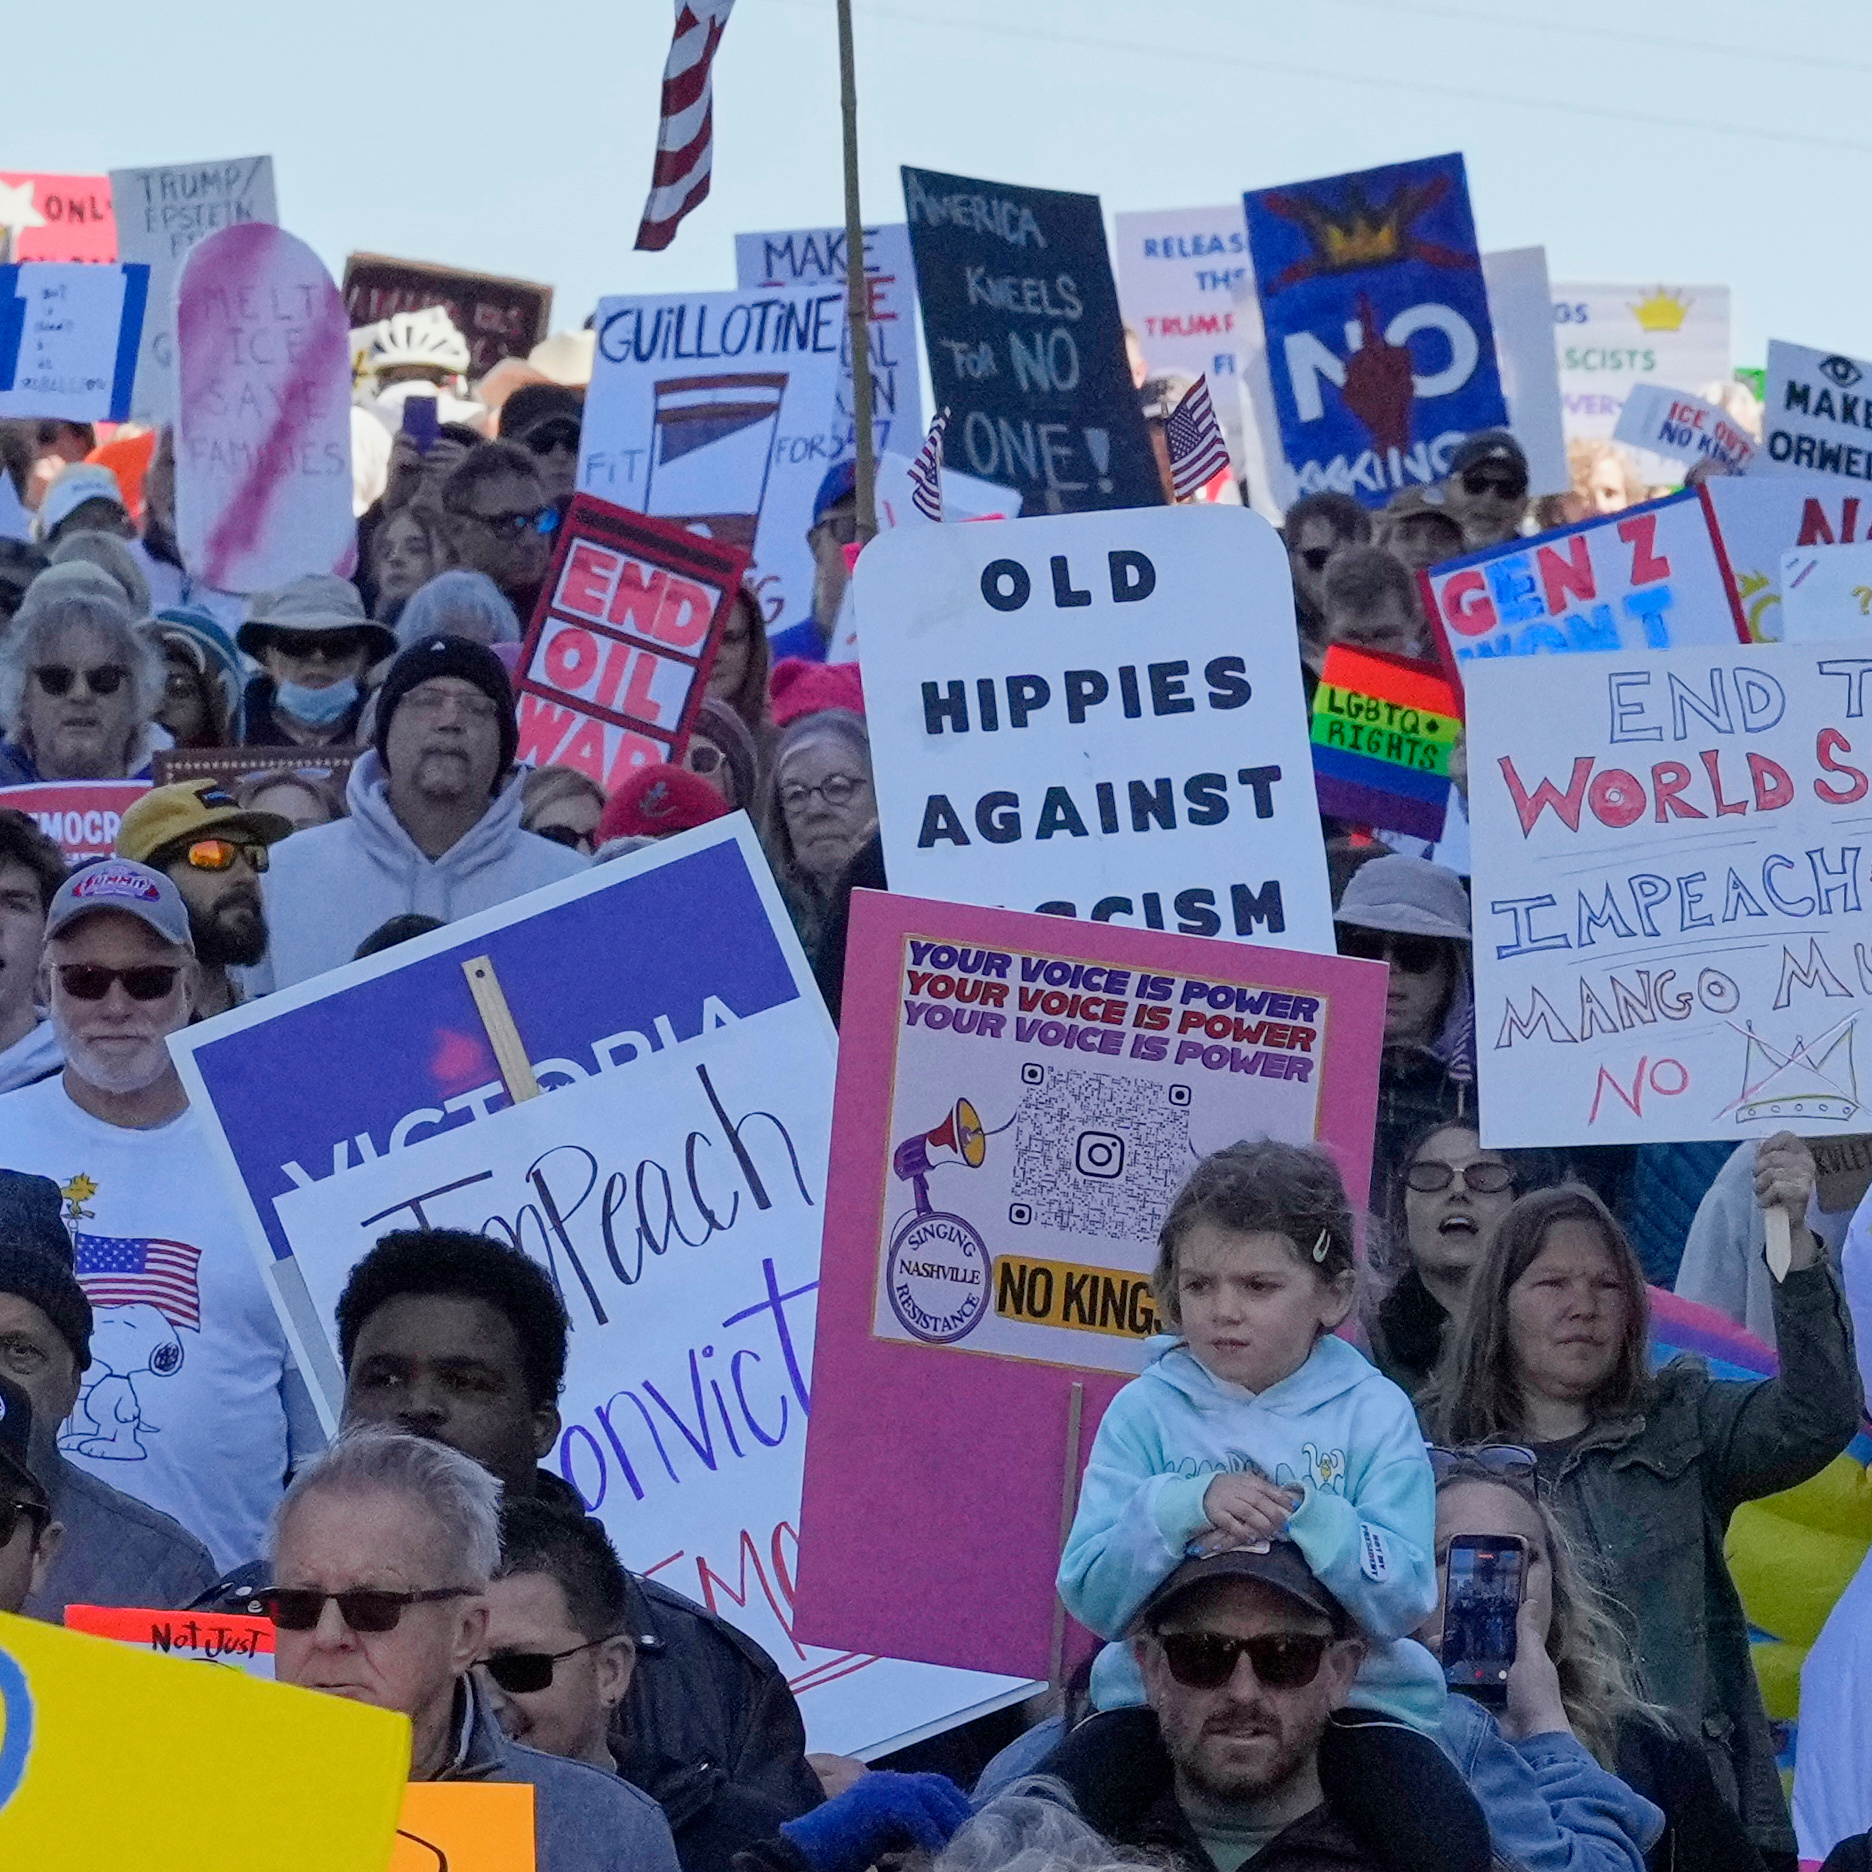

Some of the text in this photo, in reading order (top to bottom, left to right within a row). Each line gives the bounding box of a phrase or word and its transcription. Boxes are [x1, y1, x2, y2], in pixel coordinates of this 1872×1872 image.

[908, 174, 1048, 250] AMERICA
[966, 266, 1084, 321] KNEELS
[1009, 327, 1079, 394] NO
[1284, 302, 1479, 422] NO
[561, 546, 717, 651] END
[980, 549, 1158, 613] OLD
[1441, 515, 1671, 637] GEN Z
[543, 627, 663, 723] OIL
[921, 656, 1253, 736] HIPPIES
[1609, 665, 1787, 745] END
[1326, 720, 1440, 774] RIGHTS
[917, 764, 1283, 849] AGAINST
[1498, 748, 1795, 839] WORLD
[1491, 847, 1862, 961] IMPEACH
[905, 971, 1317, 1053] YOUR VOICE IS POWER
[908, 940, 1319, 1024] YOUR VOICE IS POWER
[1494, 966, 1740, 1051] MANGO
[903, 1000, 1314, 1083] YOUR VOICE IS POWER
[1588, 1055, 1690, 1126] NO
[899, 1258, 981, 1286] NASHVILLE
[906, 1222, 976, 1257] SINGING
[895, 1282, 981, 1334] RESISTANCE
[998, 1261, 1052, 1314] NO
